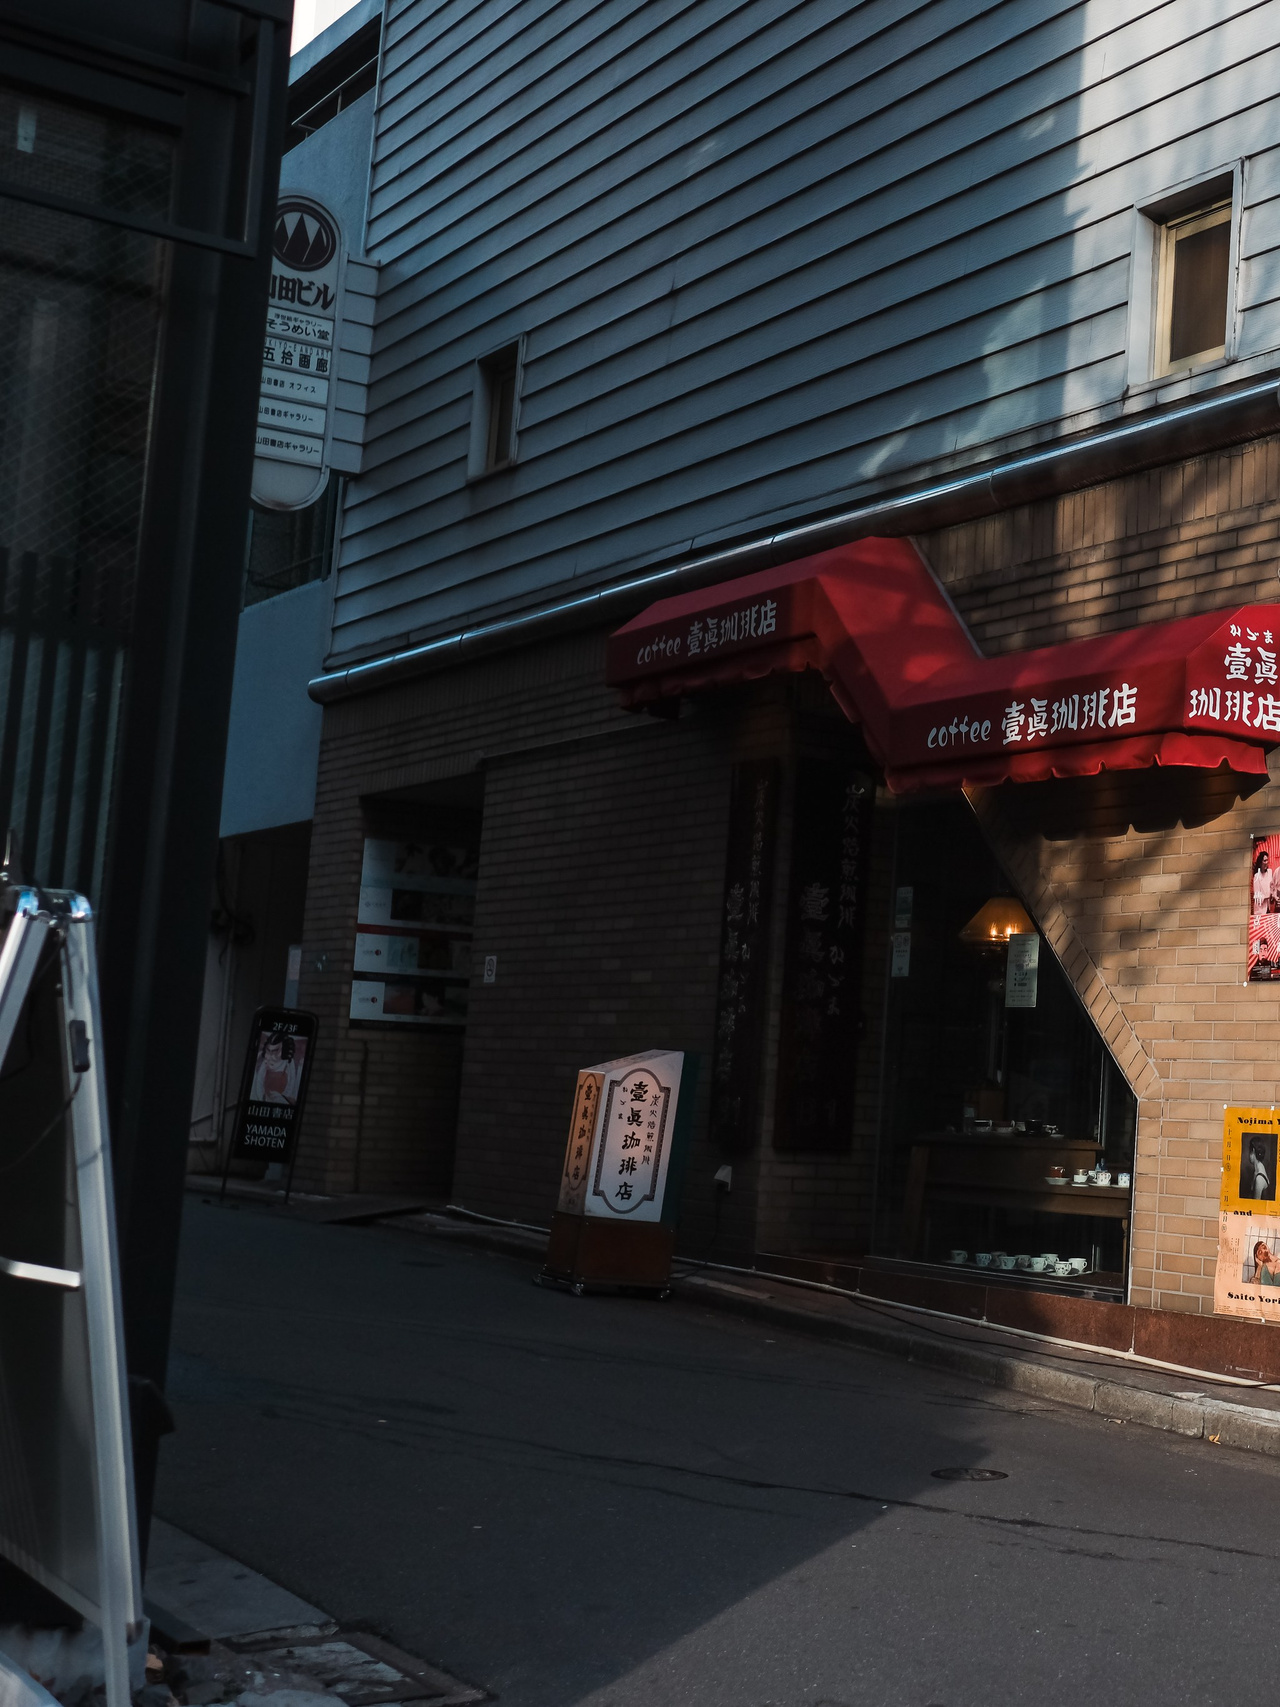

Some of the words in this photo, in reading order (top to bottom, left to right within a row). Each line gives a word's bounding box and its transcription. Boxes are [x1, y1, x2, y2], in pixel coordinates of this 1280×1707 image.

[266, 318, 330, 341] そうめい堂
[263, 346, 328, 373] 五拾画廊
[637, 625, 681, 665] coffee
[927, 715, 991, 748] coffee
[247, 1106, 294, 1120] 山田書店
[1237, 1117, 1273, 1126] Nojima
[246, 1123, 287, 1138] YAMADA
[243, 1135, 286, 1149] SHOTEN
[1233, 1209, 1253, 1217] and
[1227, 1292, 1256, 1301] Saito
